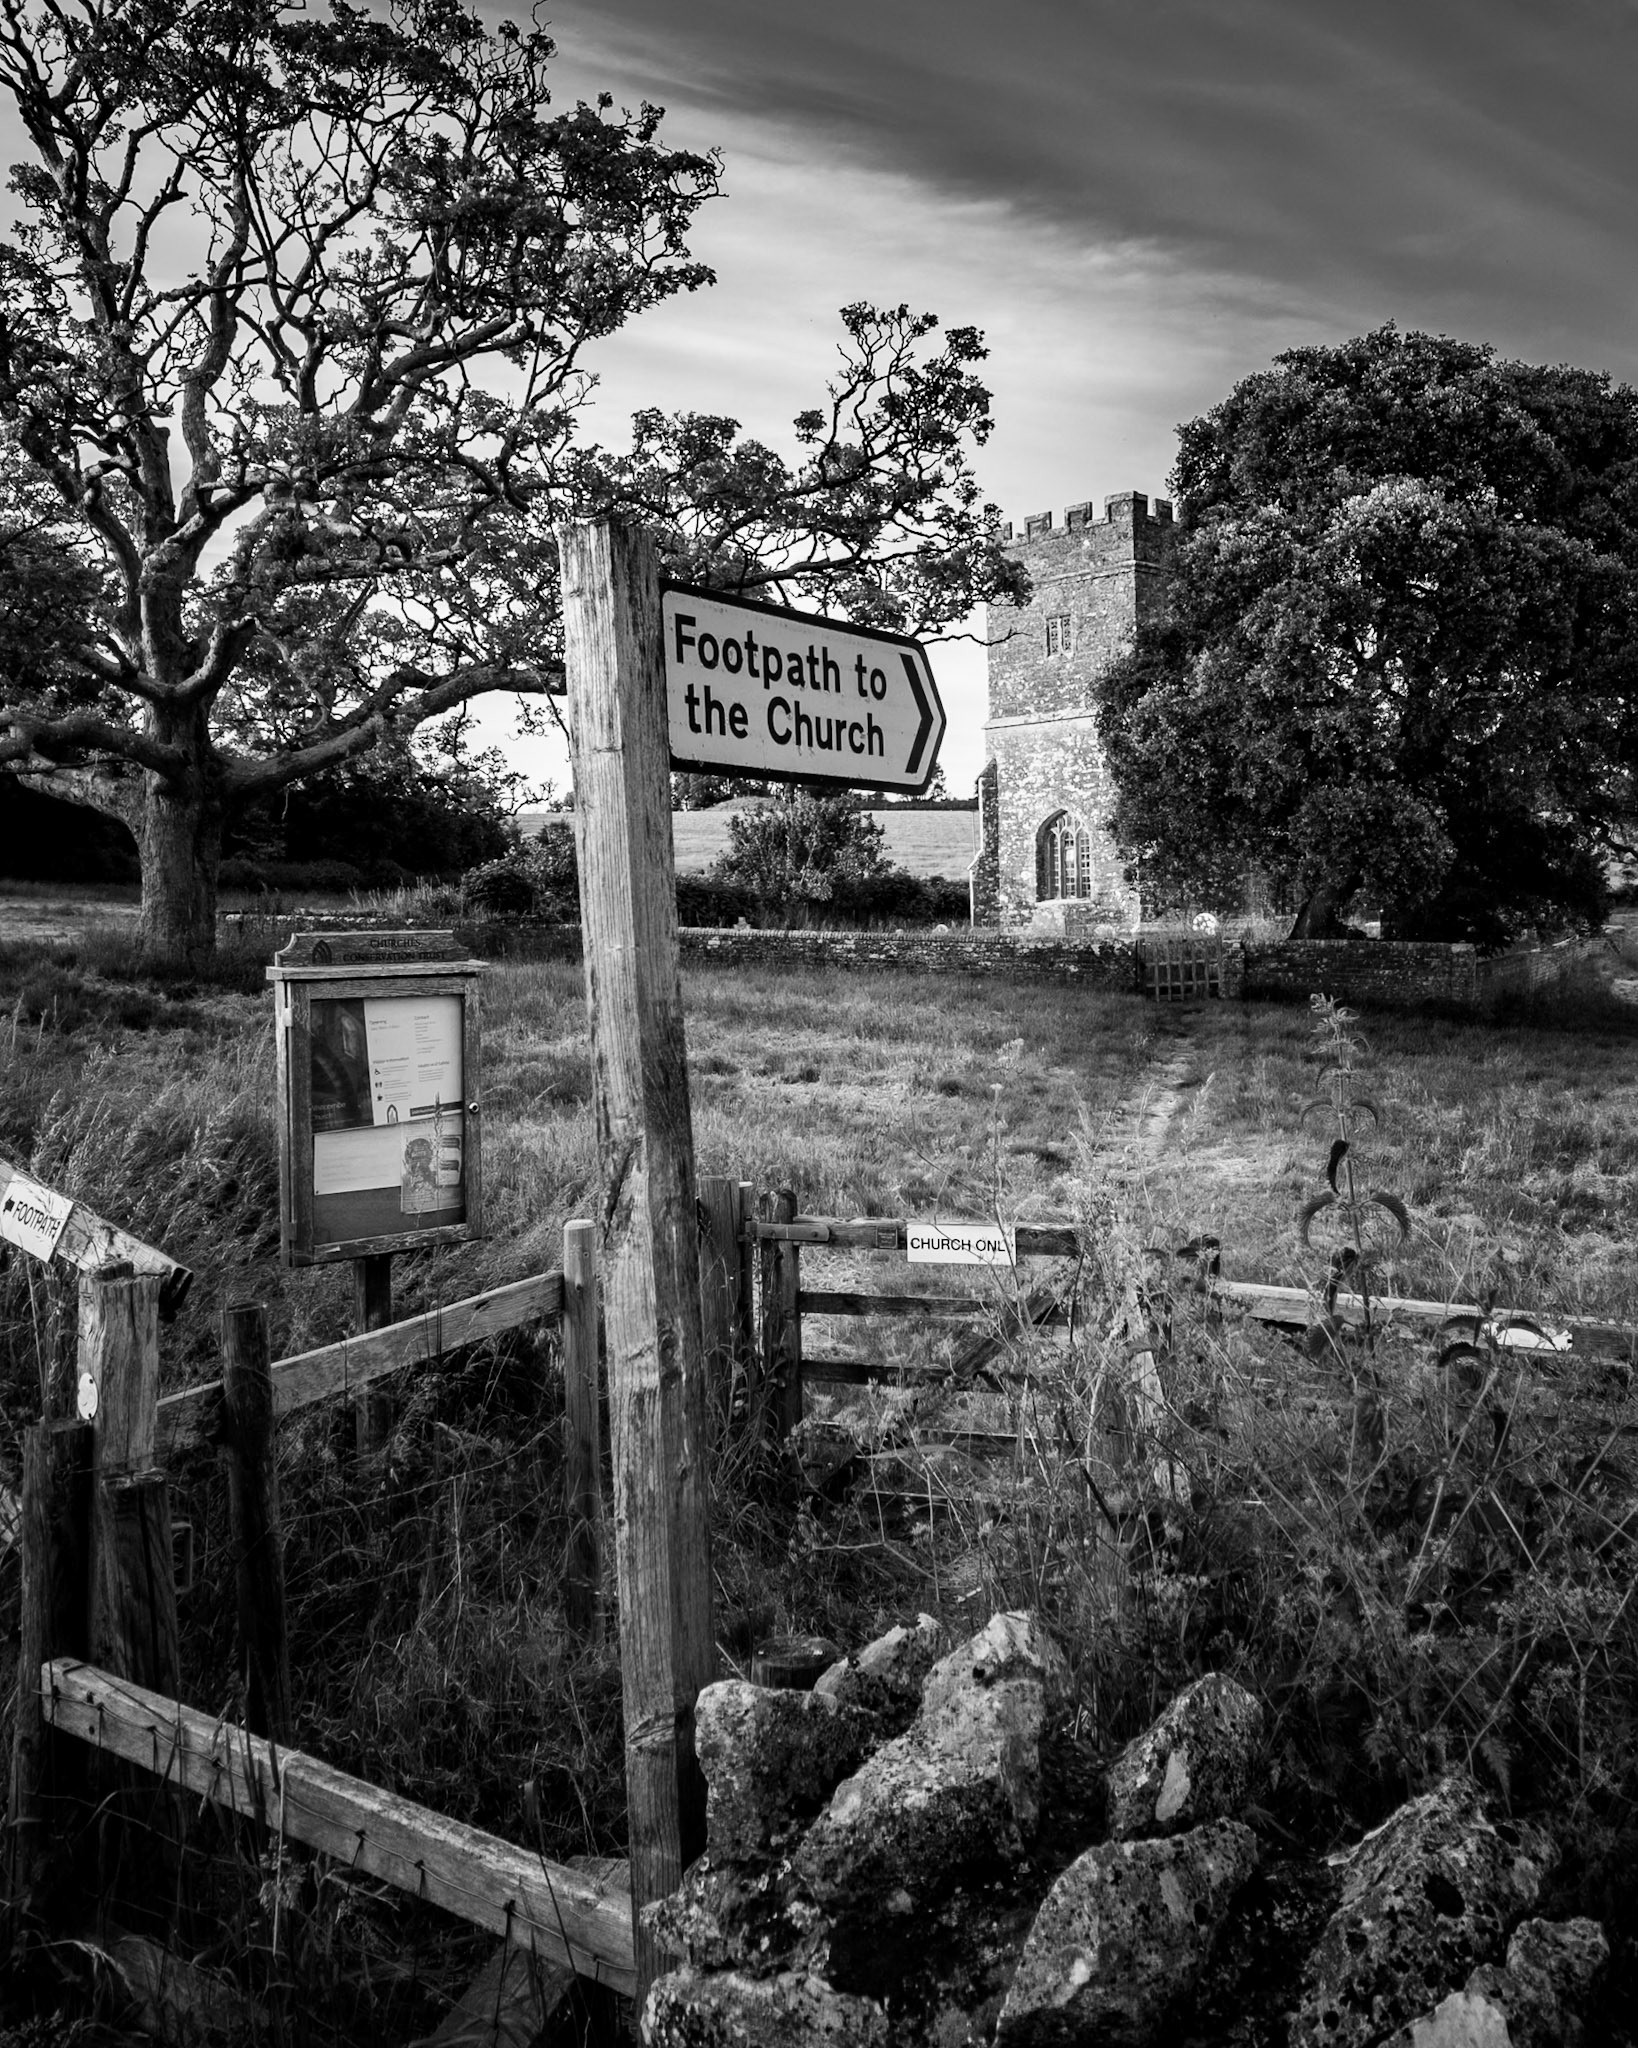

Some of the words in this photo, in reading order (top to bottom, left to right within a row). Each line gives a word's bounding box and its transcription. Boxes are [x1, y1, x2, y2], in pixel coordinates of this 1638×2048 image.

[674, 613, 841, 693] Footpath
[855, 654, 887, 700] to
[684, 683, 748, 739] the
[767, 696, 884, 757] Church
[342, 951, 415, 963] CONSERVATION
[418, 951, 445, 961] TRUST
[370, 938, 421, 949] CHURCHES
[12, 1200, 61, 1240] FOOTPATH
[910, 1237, 971, 1251] CHURCH
[975, 1239, 1010, 1252] ONL
